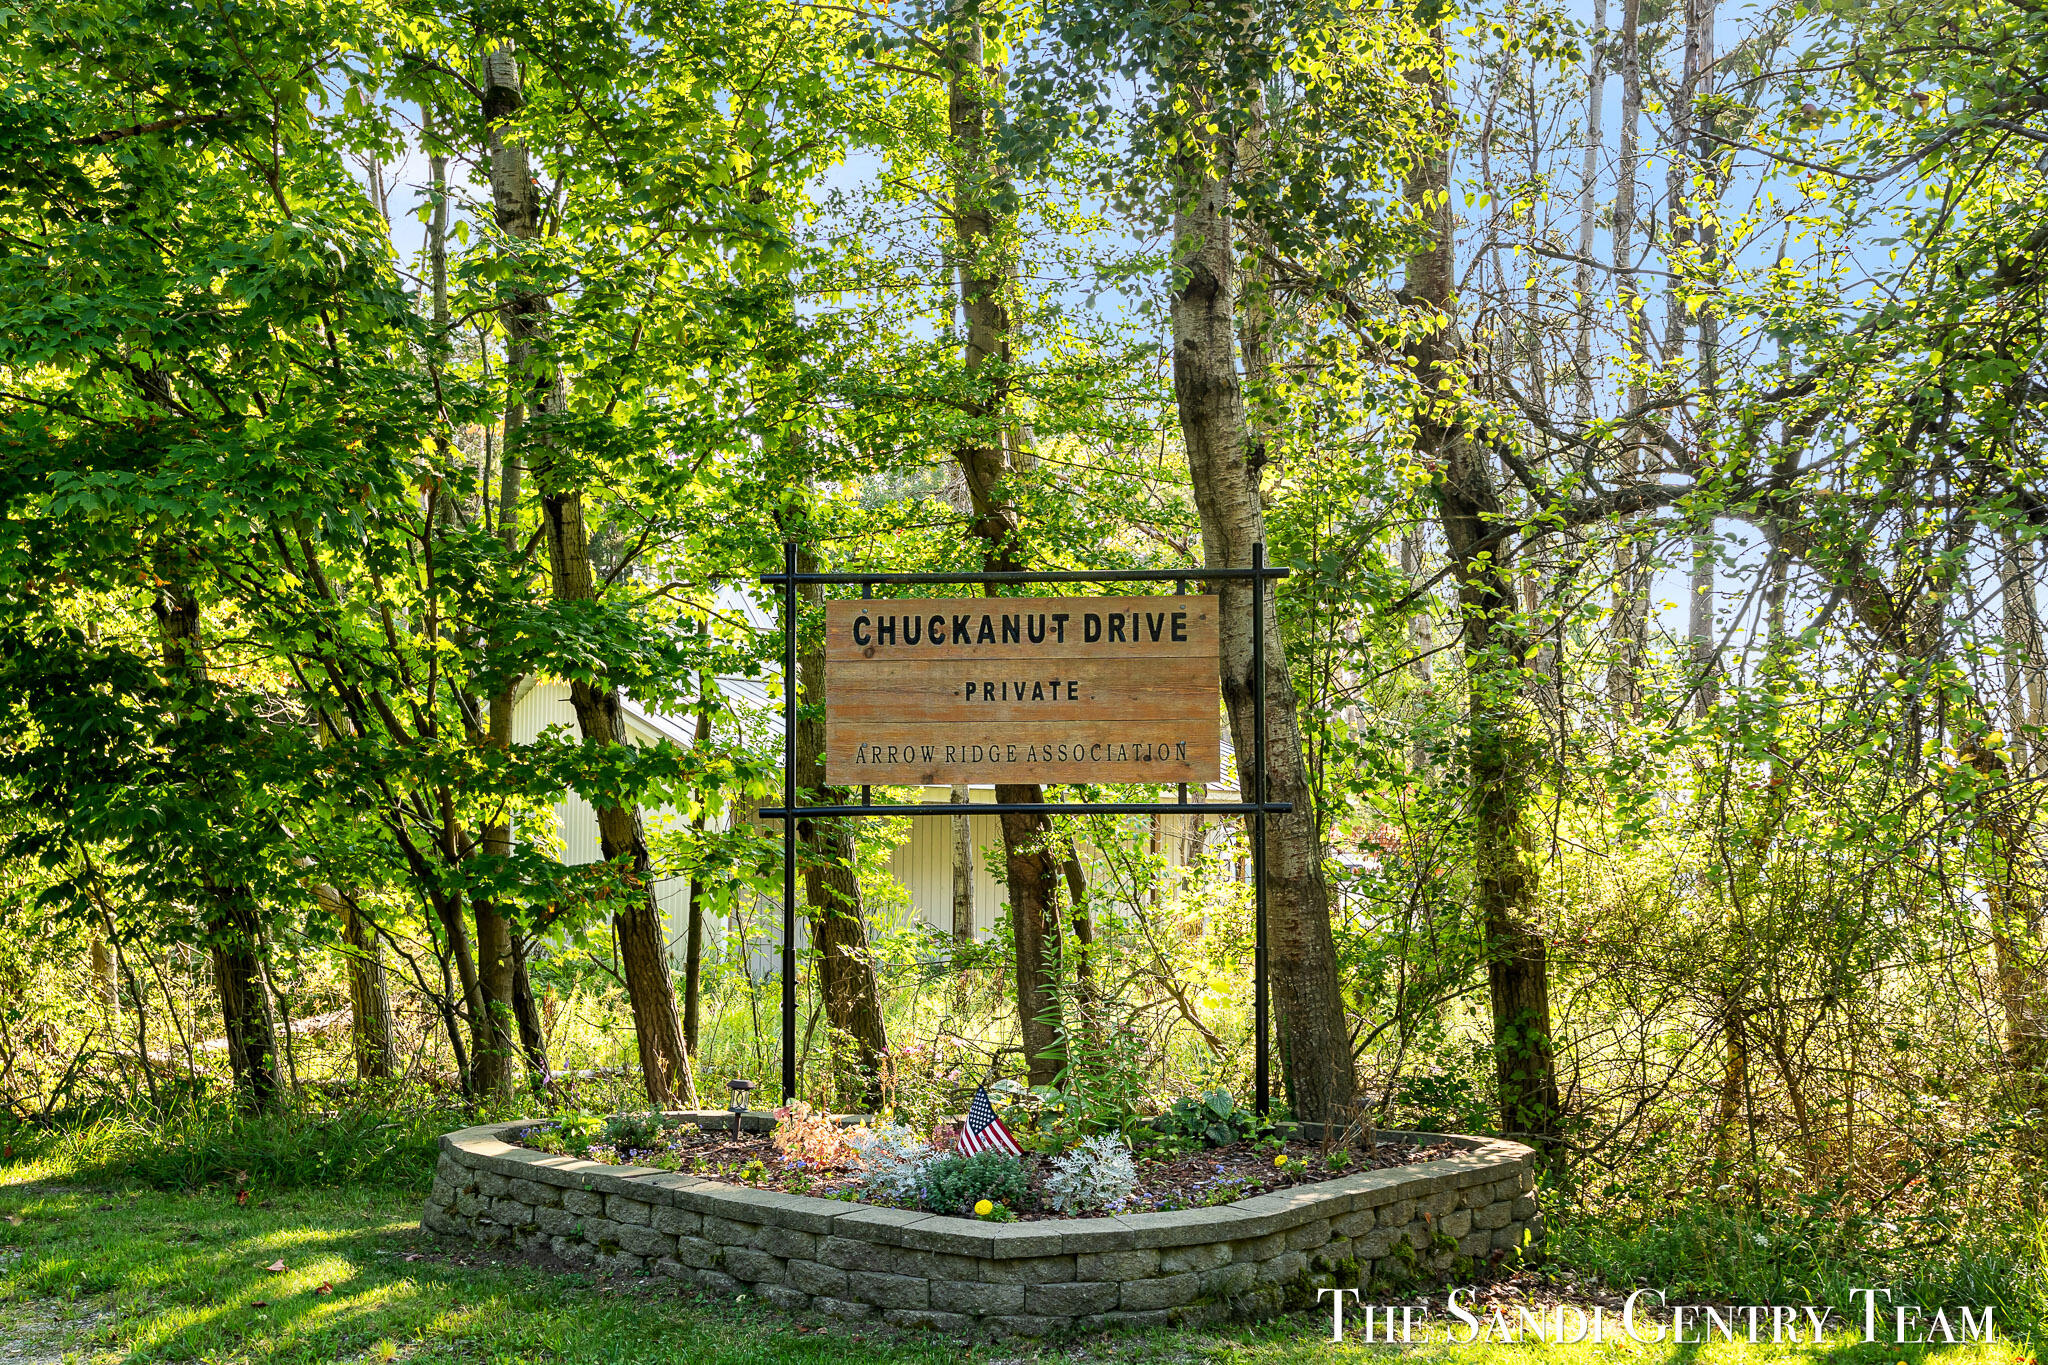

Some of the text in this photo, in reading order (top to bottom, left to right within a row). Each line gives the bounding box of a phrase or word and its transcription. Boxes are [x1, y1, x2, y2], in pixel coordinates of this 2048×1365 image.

[853, 612, 1188, 646] CHUCKANUT DRIVE
[965, 681, 1079, 701] PRIVATE
[856, 742, 1187, 764] ARROW RIDGE ASSOCIATION
